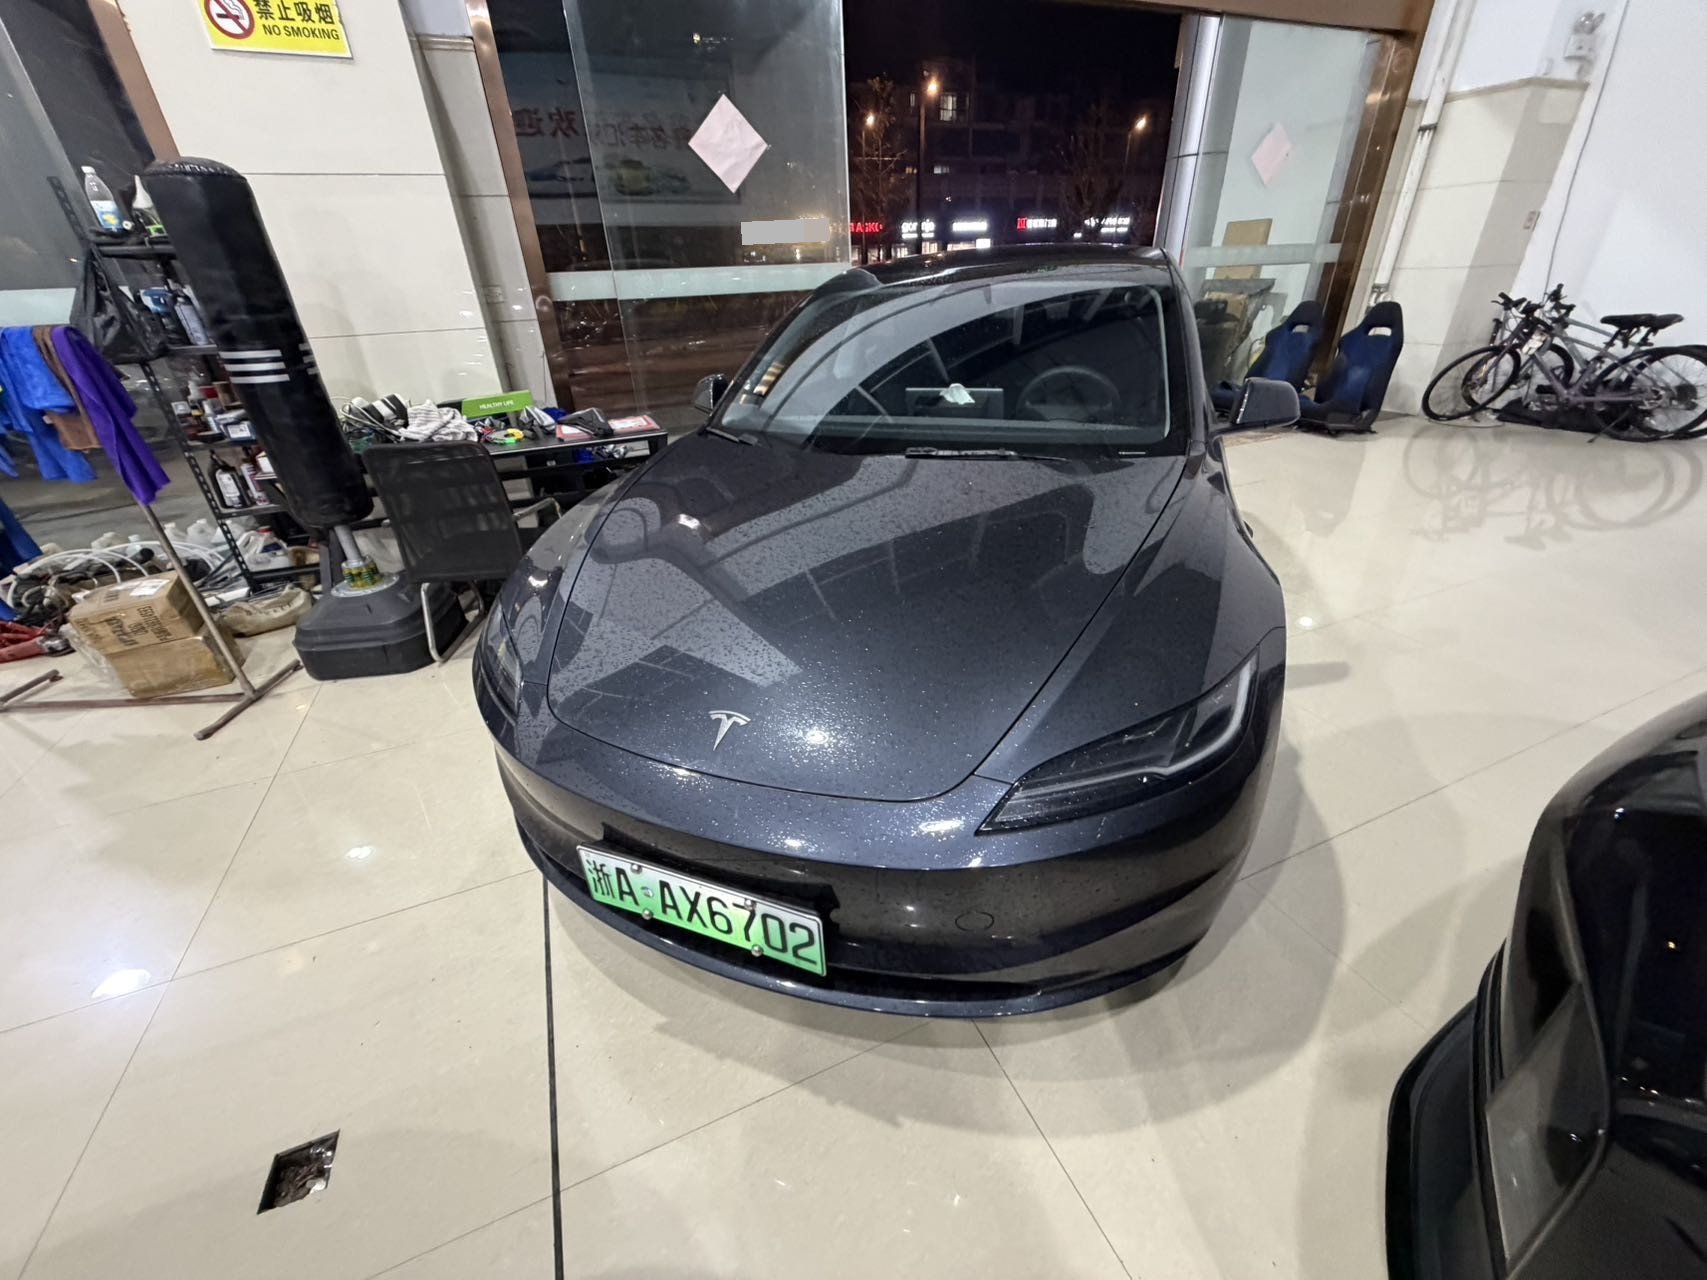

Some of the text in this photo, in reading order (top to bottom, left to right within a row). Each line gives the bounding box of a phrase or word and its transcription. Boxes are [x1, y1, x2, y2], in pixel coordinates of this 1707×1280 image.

[255, 0, 335, 25] 禁止吸烟
[262, 24, 340, 41] NO SMOKING
